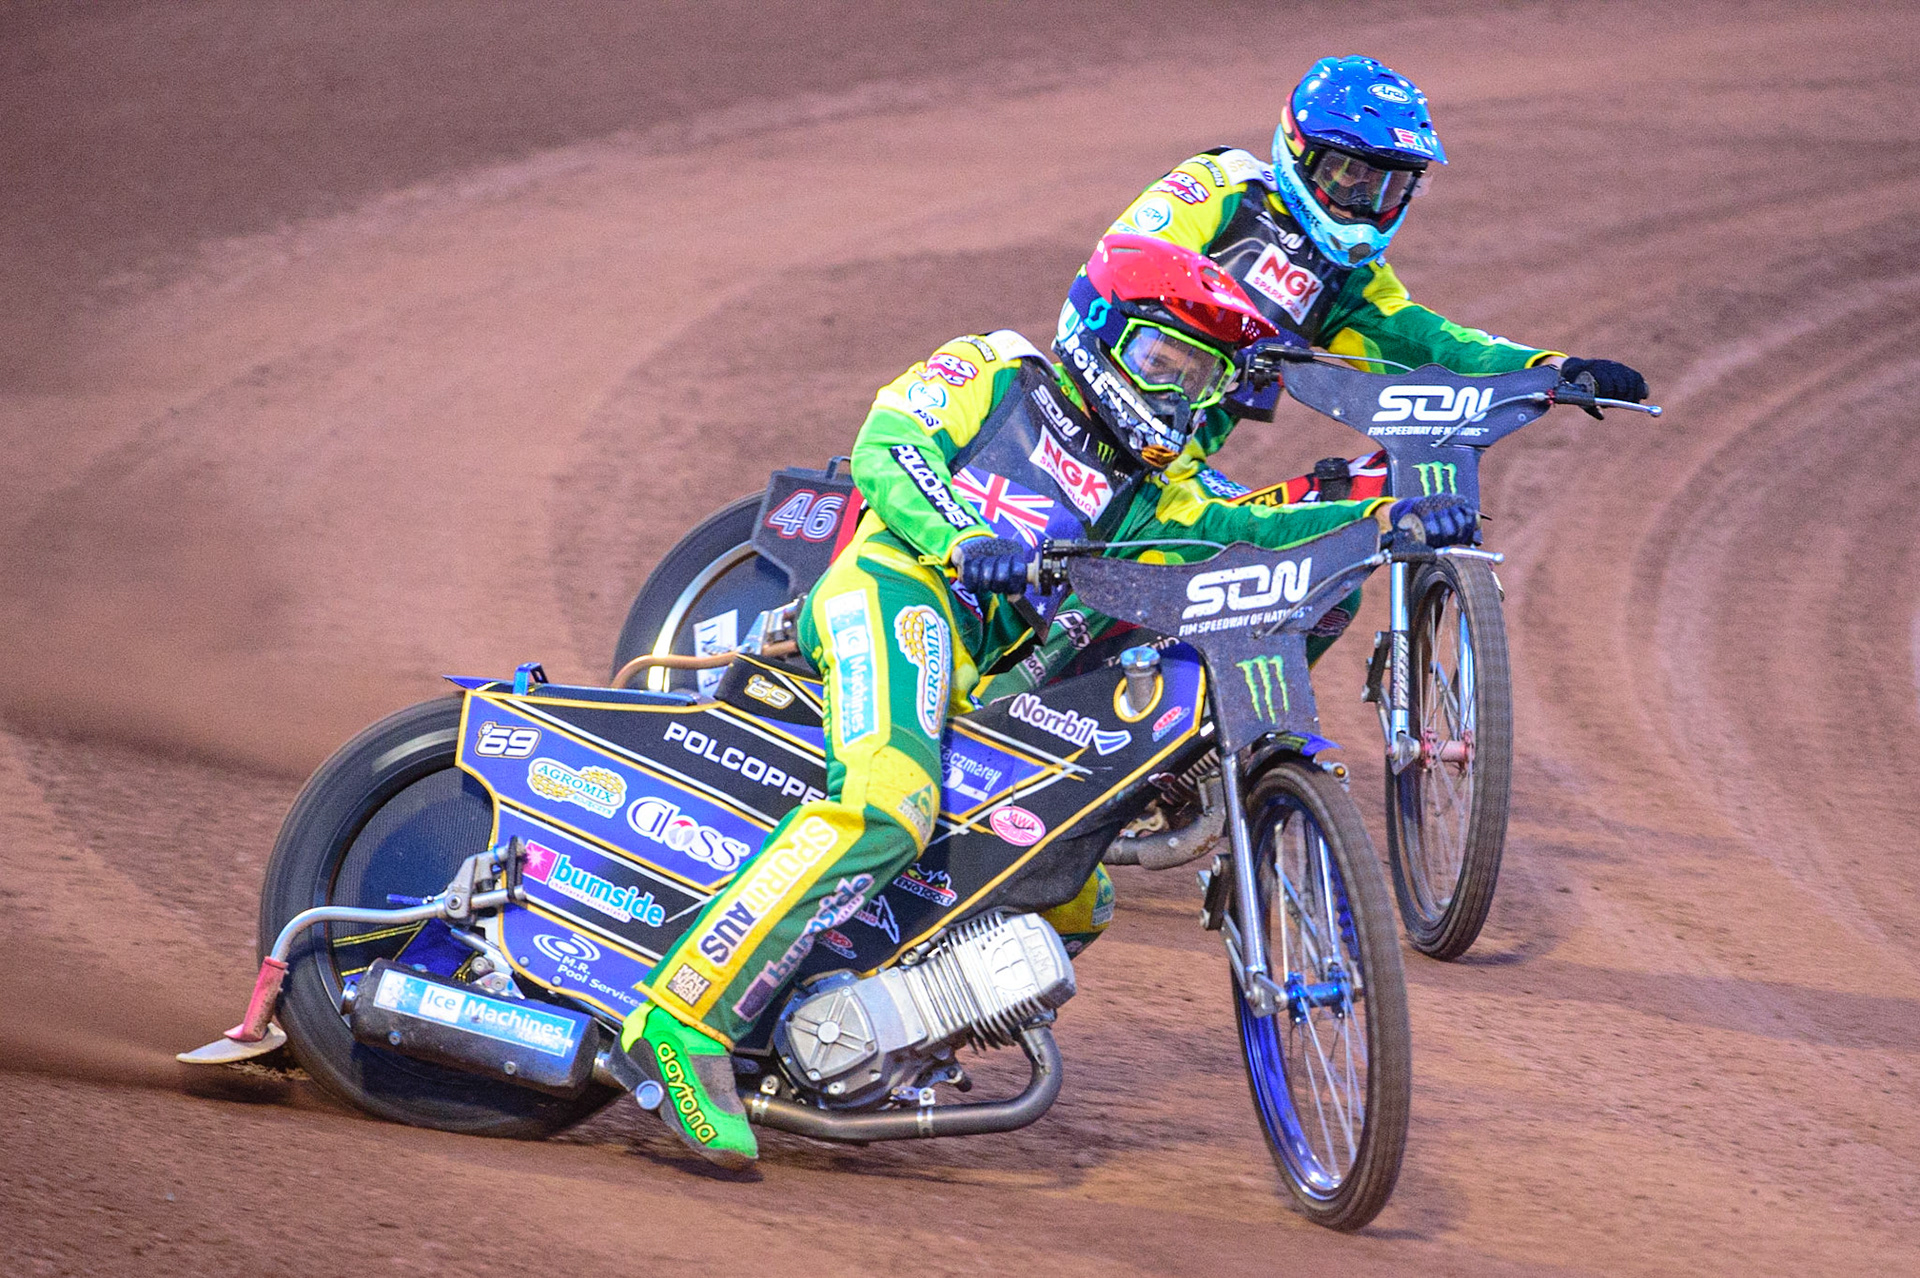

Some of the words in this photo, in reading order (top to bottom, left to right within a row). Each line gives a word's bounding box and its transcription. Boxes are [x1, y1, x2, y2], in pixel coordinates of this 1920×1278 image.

[1367, 427, 1384, 436] FIM
[1385, 426, 1430, 436] SPEEDWAY
[1431, 427, 1443, 436] OF
[1040, 456, 1065, 486] SPARK
[1067, 488, 1097, 517] PLUGS
[1044, 435, 1108, 506] NGK
[766, 491, 847, 540] 46
[1179, 624, 1198, 637] FIM
[1198, 616, 1250, 634] SPEEDWAY
[1250, 612, 1264, 626] OF
[848, 656, 868, 733] Machines
[925, 619, 941, 727] AGROMIX
[1010, 692, 1097, 747] Norrbil
[538, 765, 614, 803] AGROMIX
[663, 721, 830, 805] POLCOPPE
[1003, 811, 1036, 831] JAWA
[554, 856, 663, 925] burnside
[767, 876, 872, 982] burnside
[557, 964, 588, 984] Pool
[589, 978, 642, 1007] Service
[562, 956, 591, 975] M.R.
[428, 990, 456, 1010] Ice
[464, 1000, 564, 1039] Machines
[657, 1043, 718, 1143] daytona
